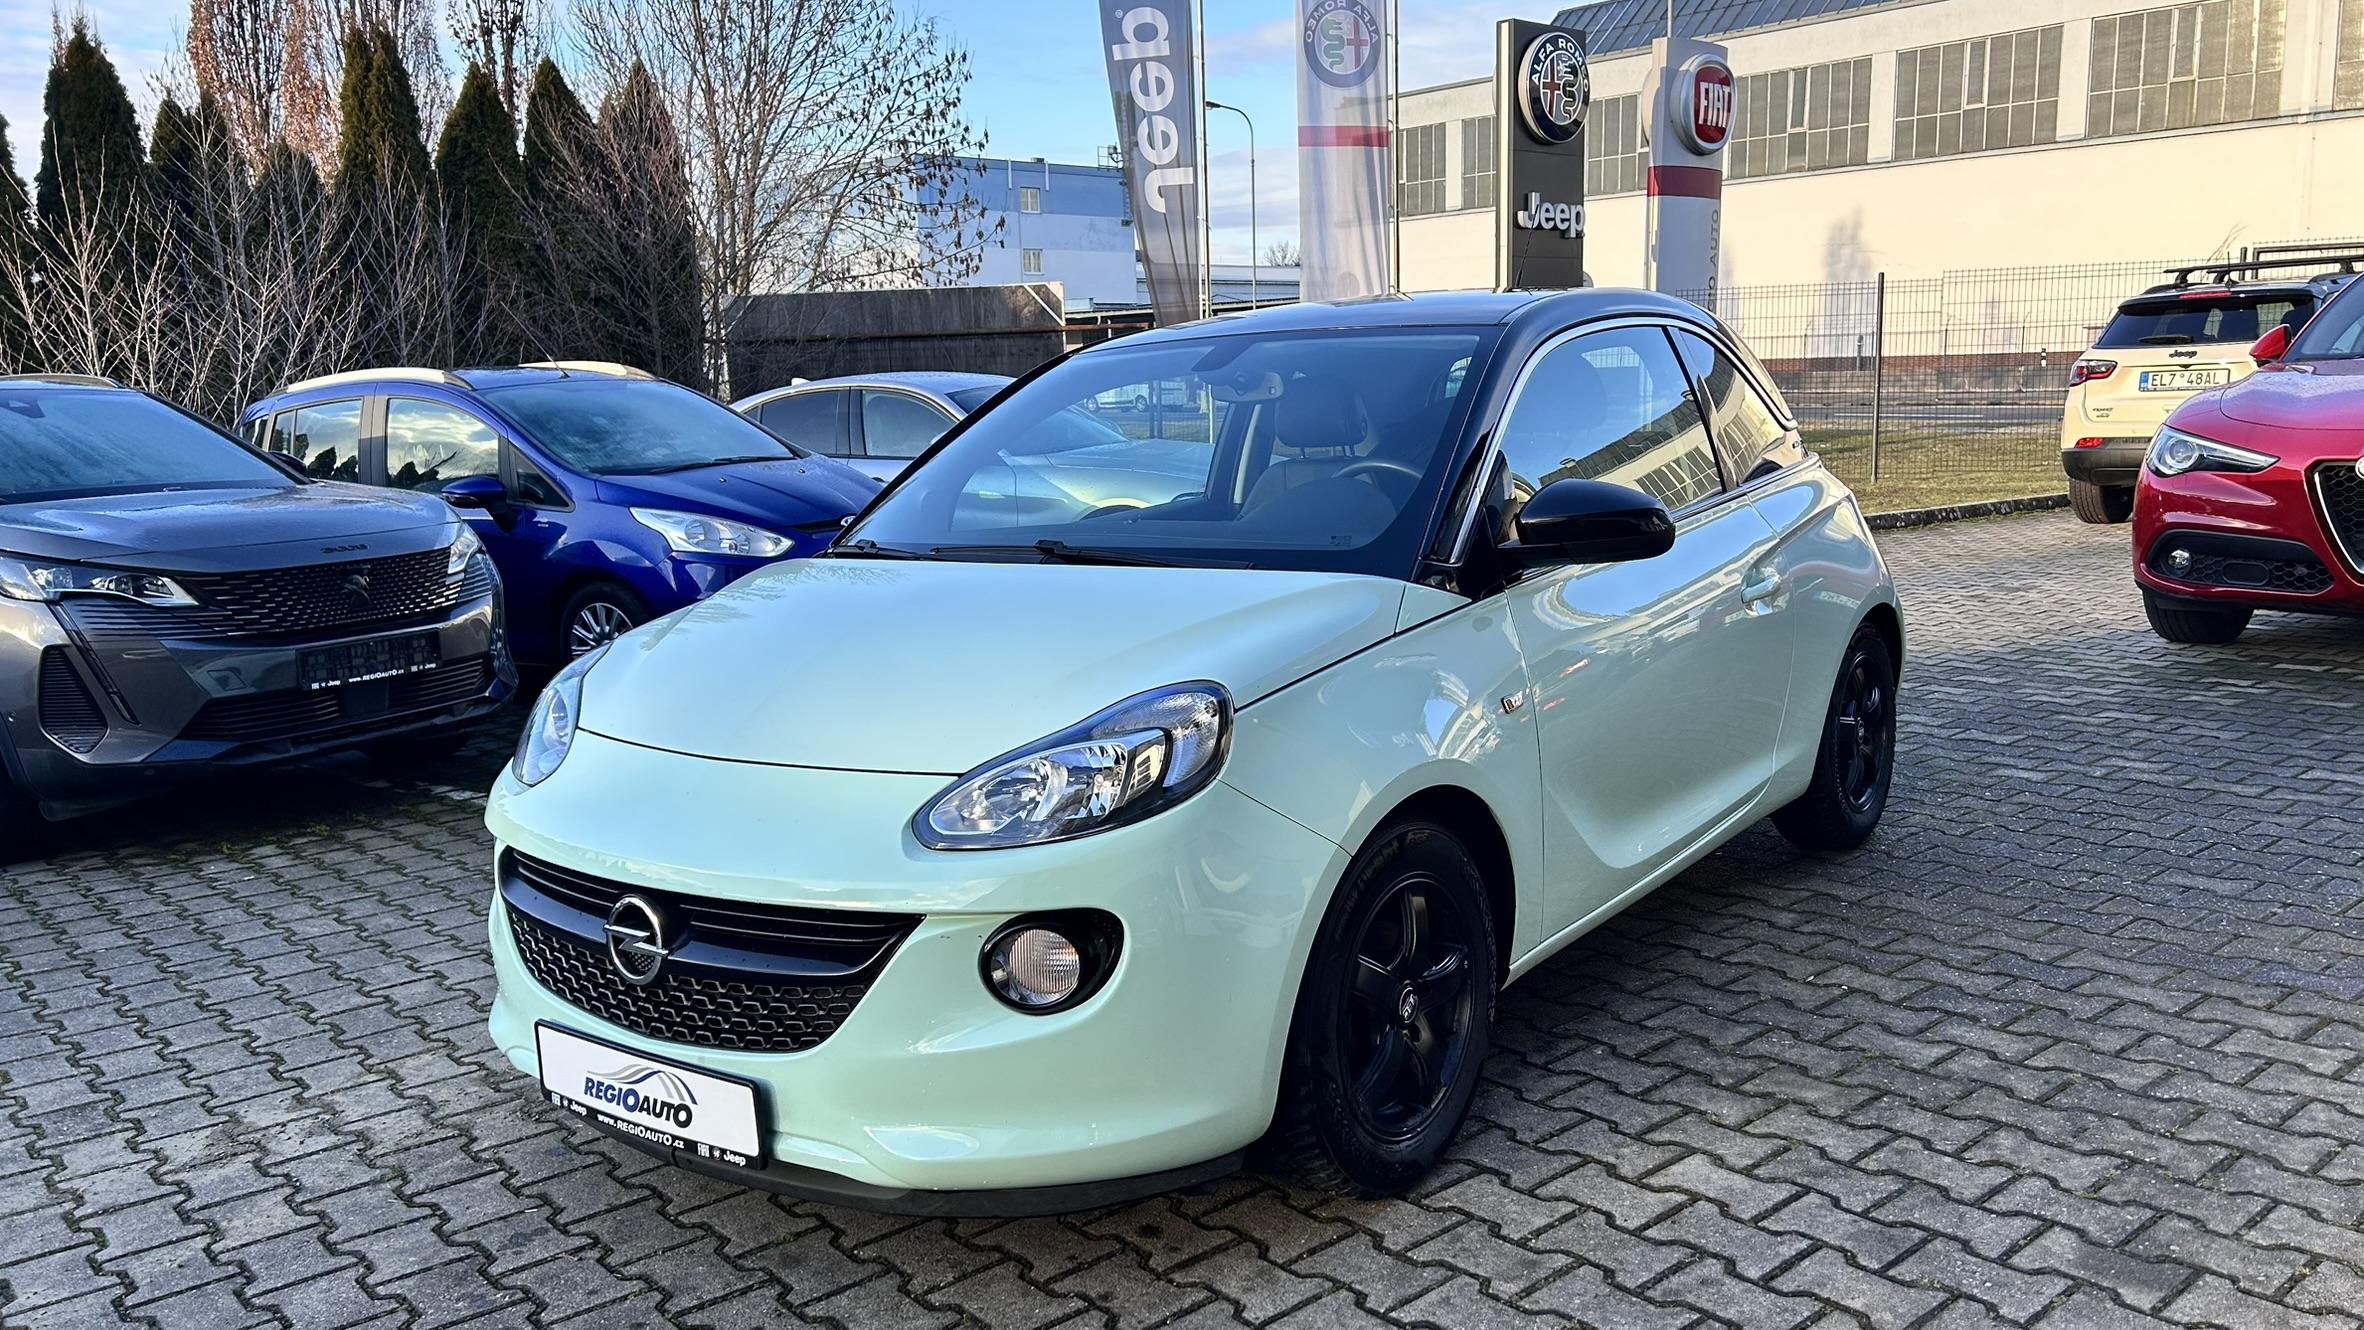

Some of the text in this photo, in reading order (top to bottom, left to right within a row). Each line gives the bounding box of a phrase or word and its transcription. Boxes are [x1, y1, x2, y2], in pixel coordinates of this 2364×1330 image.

[1531, 38, 1588, 92] ALFA ROMEO
[1112, 7, 1193, 214] Jeep
[1698, 81, 1731, 128] FIAT
[1517, 191, 1585, 238] Jeep
[1710, 208, 1719, 268] AUTO
[2168, 349, 2198, 359] Jeep
[583, 1076, 692, 1129] REGIOAUTO
[723, 1150, 746, 1167] Jeep
